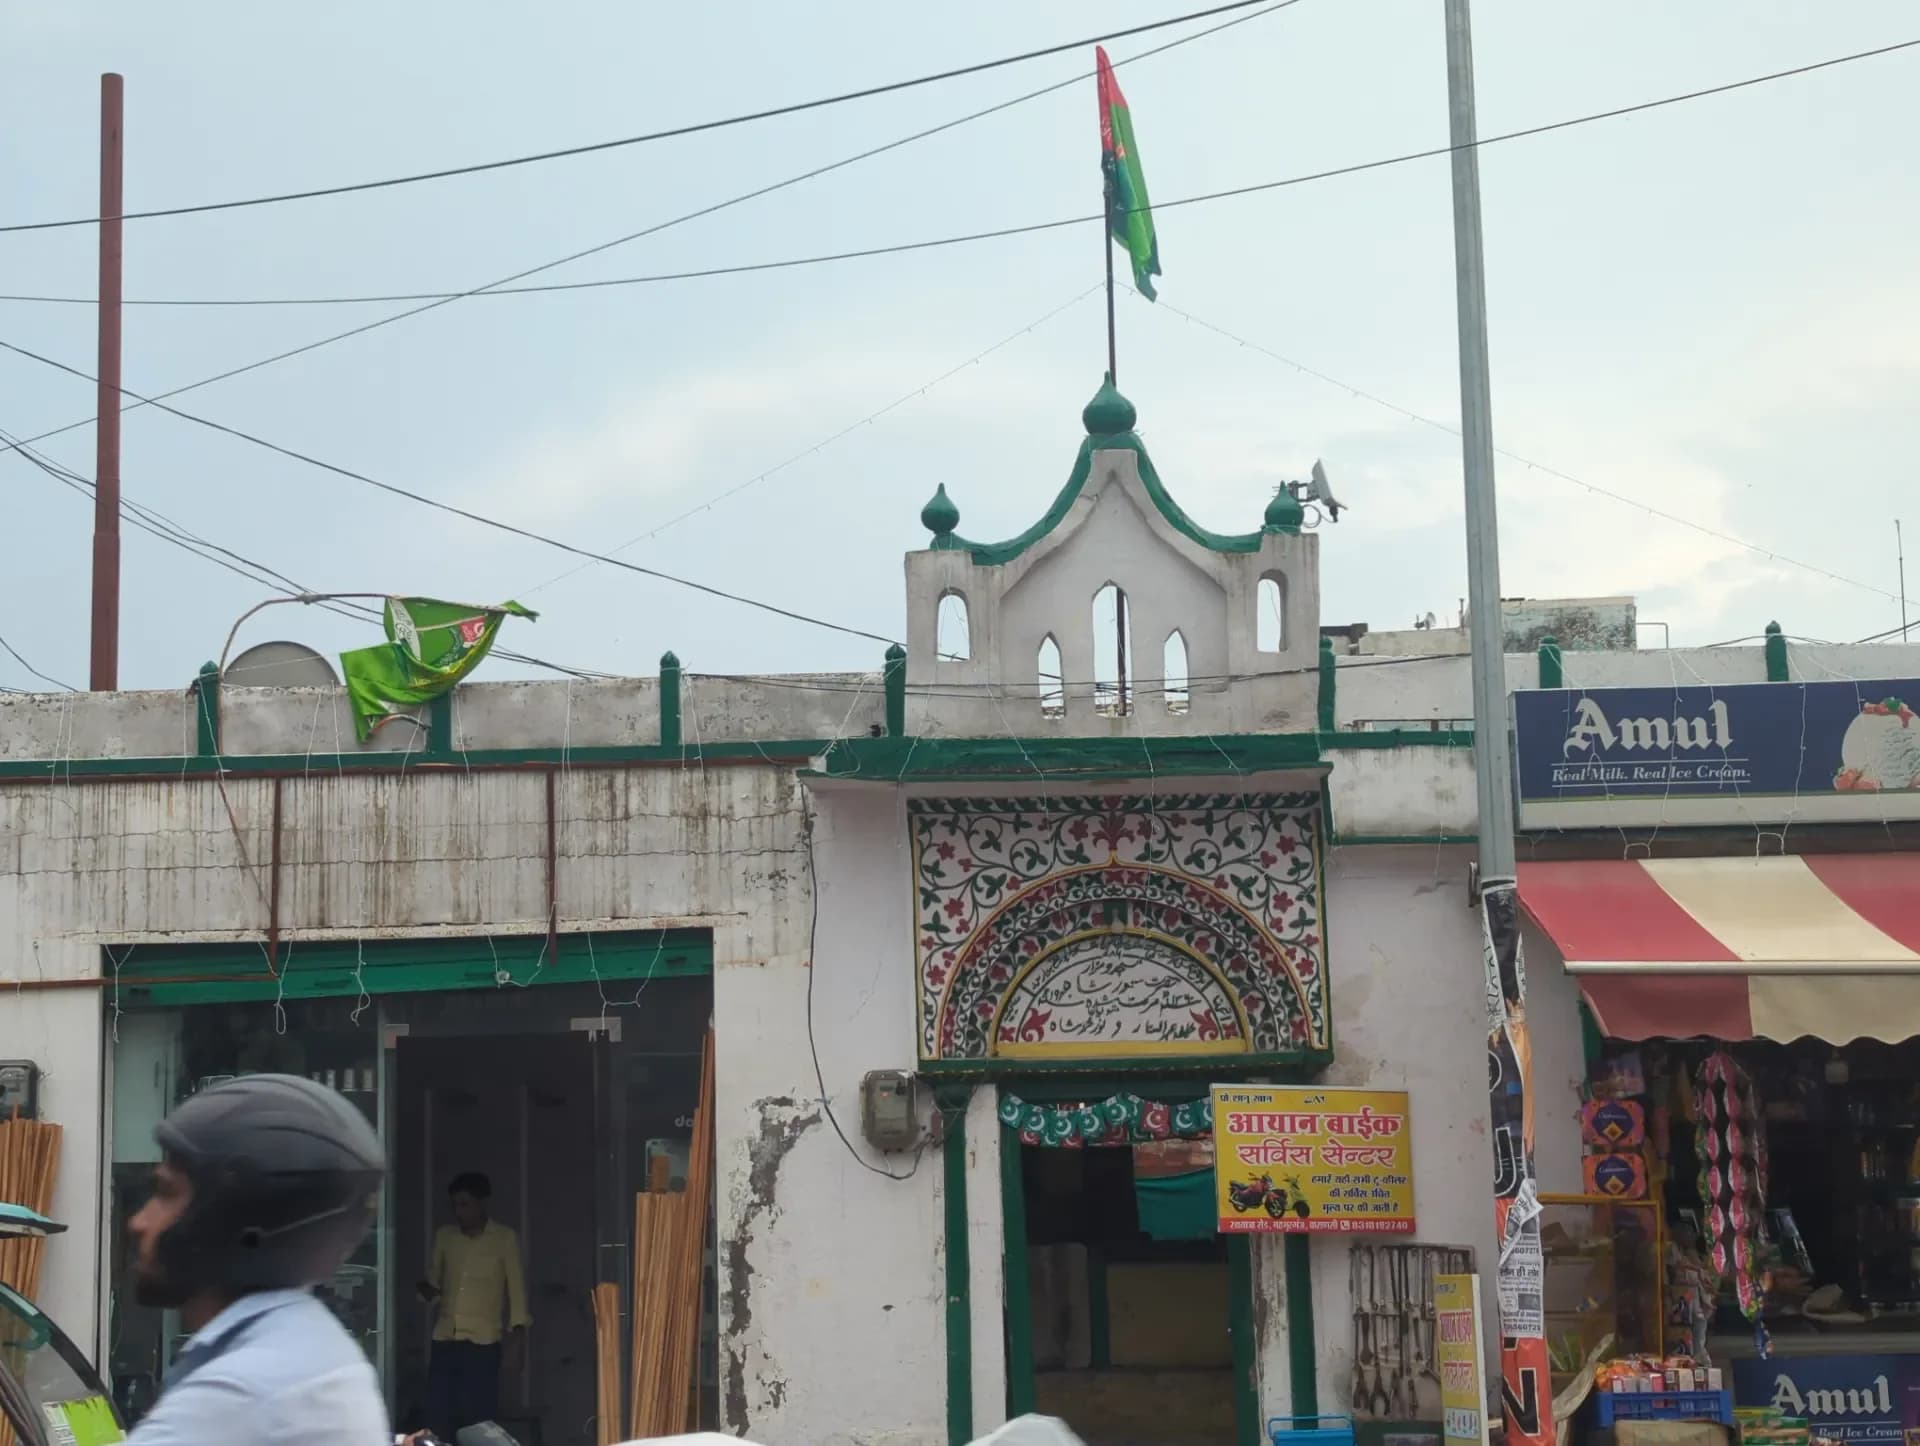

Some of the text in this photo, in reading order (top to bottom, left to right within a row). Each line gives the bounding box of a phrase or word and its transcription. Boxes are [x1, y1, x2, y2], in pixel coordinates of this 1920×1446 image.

[1564, 698, 1733, 758] Amul
[1552, 764, 1751, 782] Real Milk. Real Ice Cream.
[1229, 1107, 1401, 1139] आयान बाईक
[1238, 1139, 1395, 1167] सर्विस सेन्टर
[1329, 1188, 1340, 1198] की
[1344, 1204, 1355, 1212] पर
[1357, 1202, 1368, 1212] की
[1371, 1203, 1391, 1212] जाती
[1770, 1373, 1892, 1415] Amul
[1846, 1426, 1863, 1437] Ice
[1866, 1425, 1903, 1437] Cream
